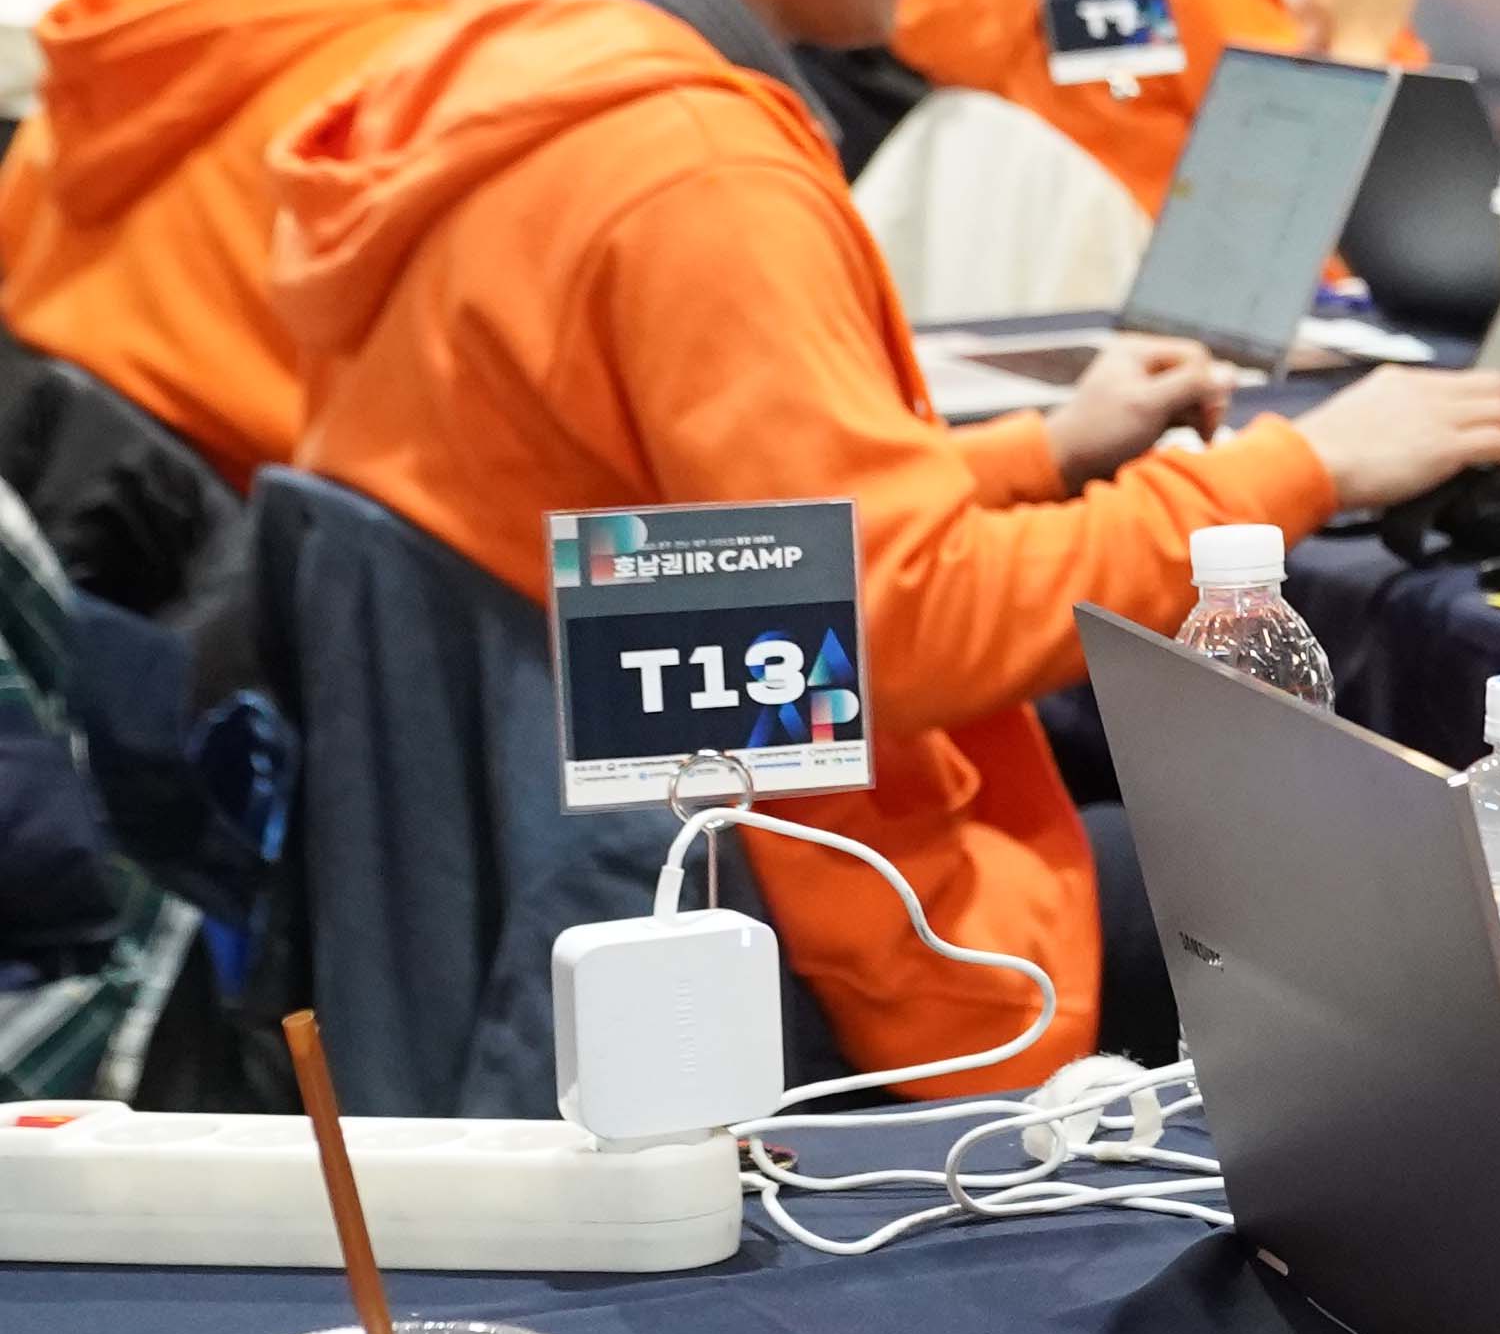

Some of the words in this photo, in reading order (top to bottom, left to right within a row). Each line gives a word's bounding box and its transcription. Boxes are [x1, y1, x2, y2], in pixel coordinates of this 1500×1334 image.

[613, 551, 684, 579] 호남권
[686, 549, 716, 575] IR
[717, 545, 804, 573] CAMP
[619, 639, 806, 714] T13
